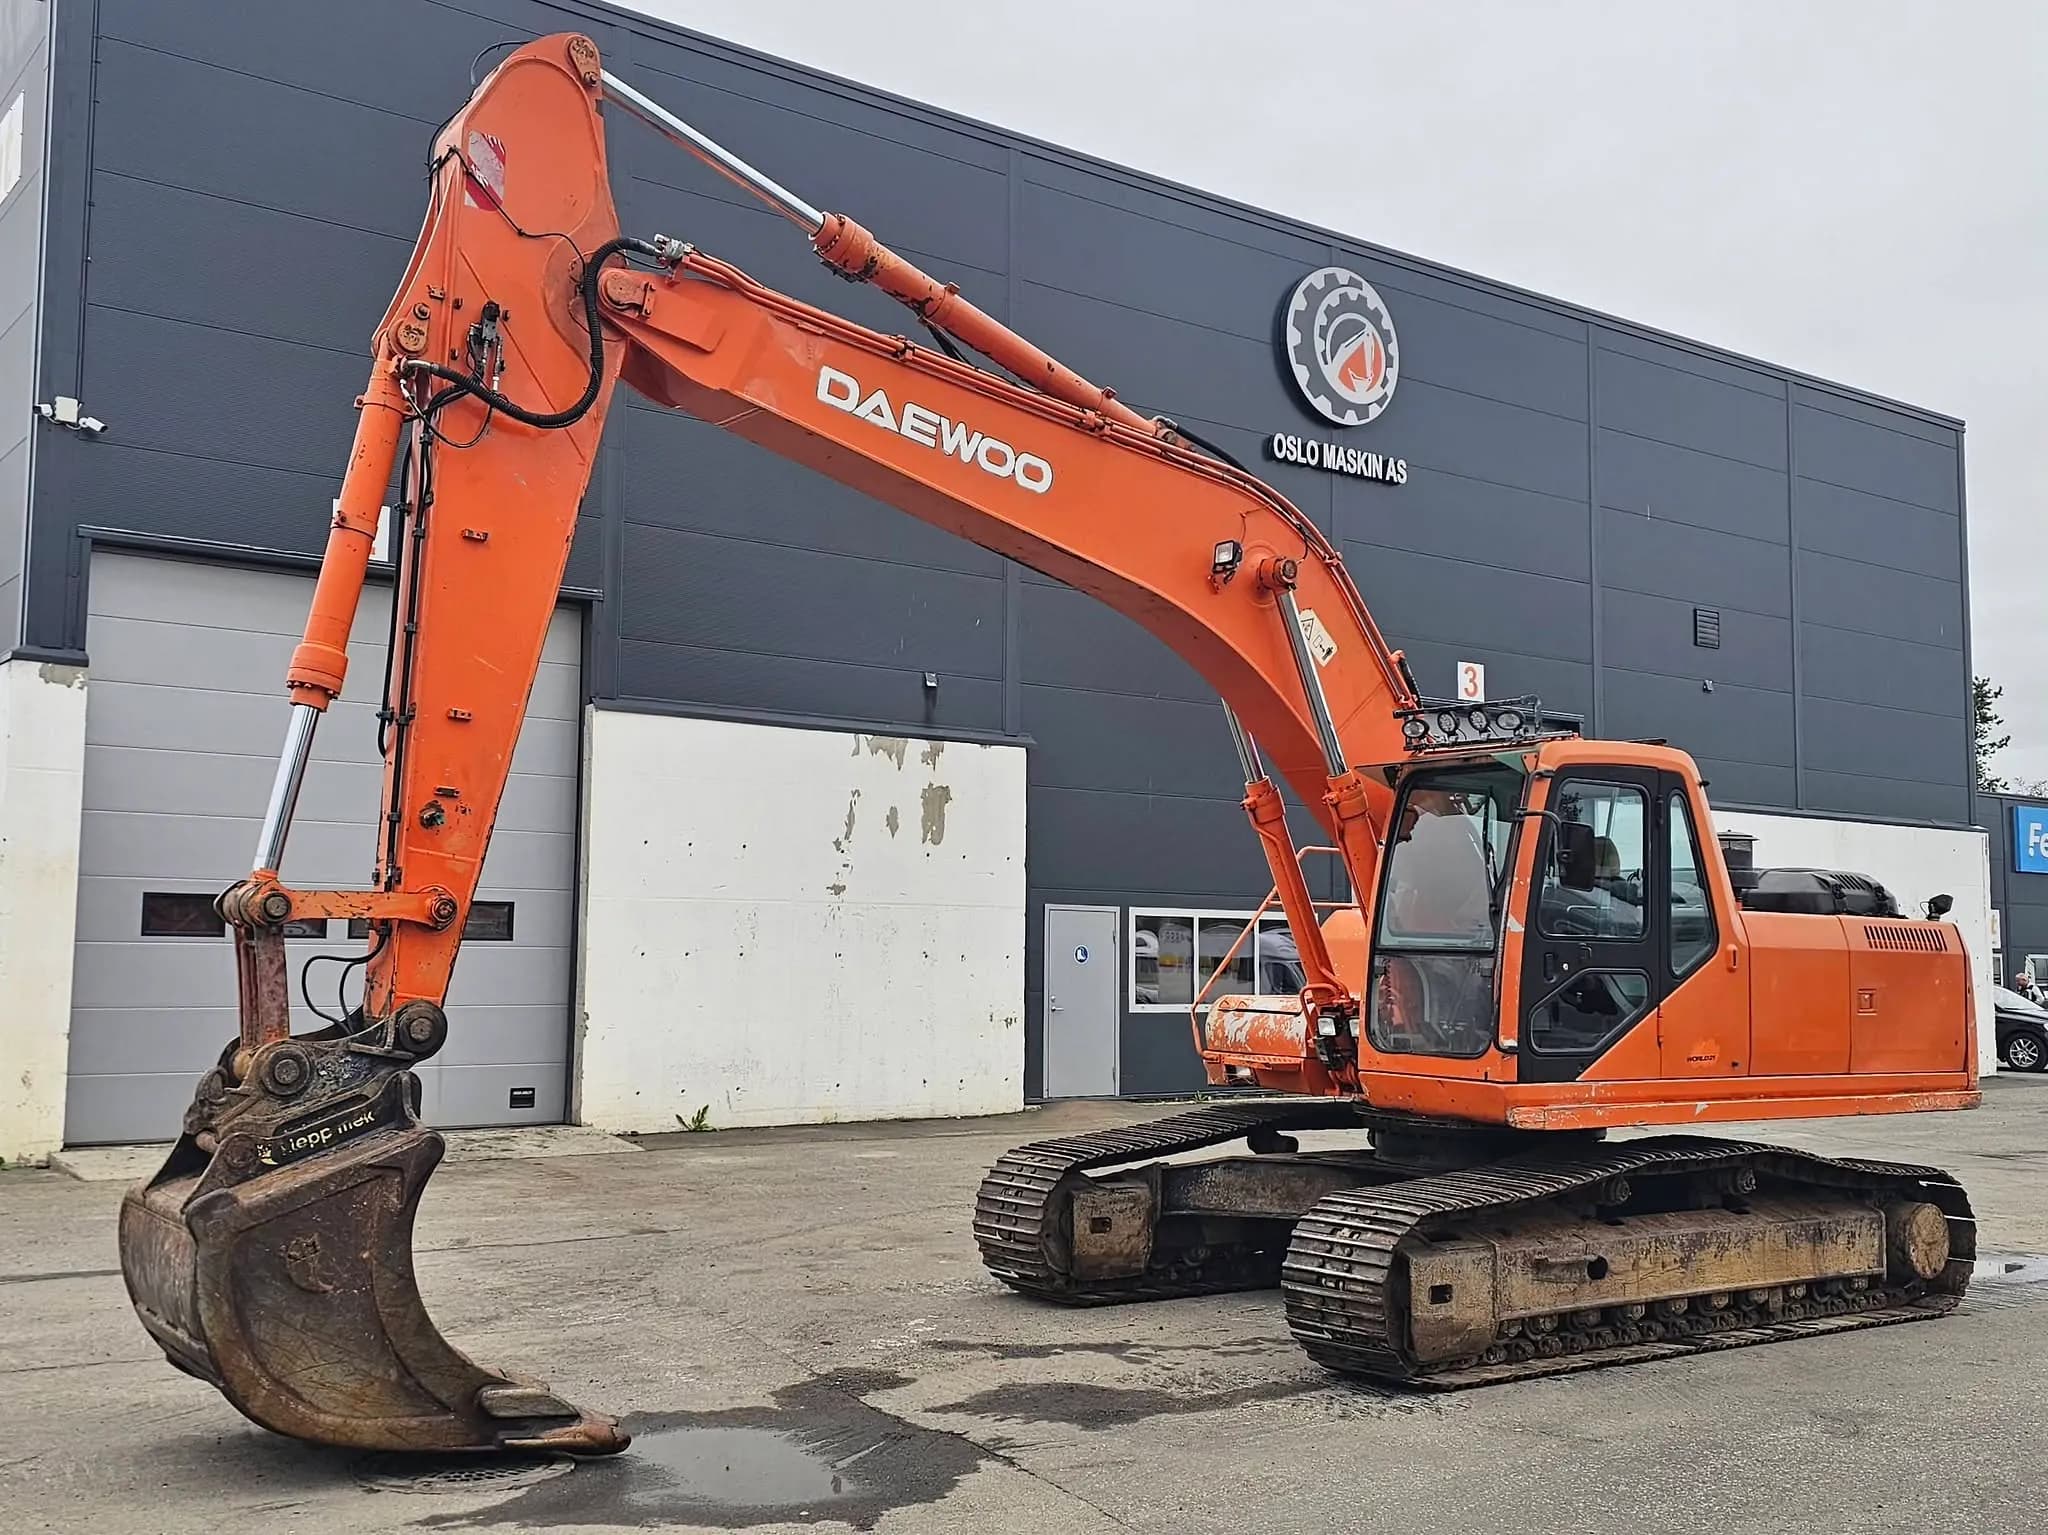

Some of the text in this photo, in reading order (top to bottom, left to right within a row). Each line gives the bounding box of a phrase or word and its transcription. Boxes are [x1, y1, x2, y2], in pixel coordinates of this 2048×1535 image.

[816, 365, 1054, 494] DAEWOO
[1273, 432, 1408, 484] OSLO MASKIN AS
[1464, 666, 1478, 697] 3
